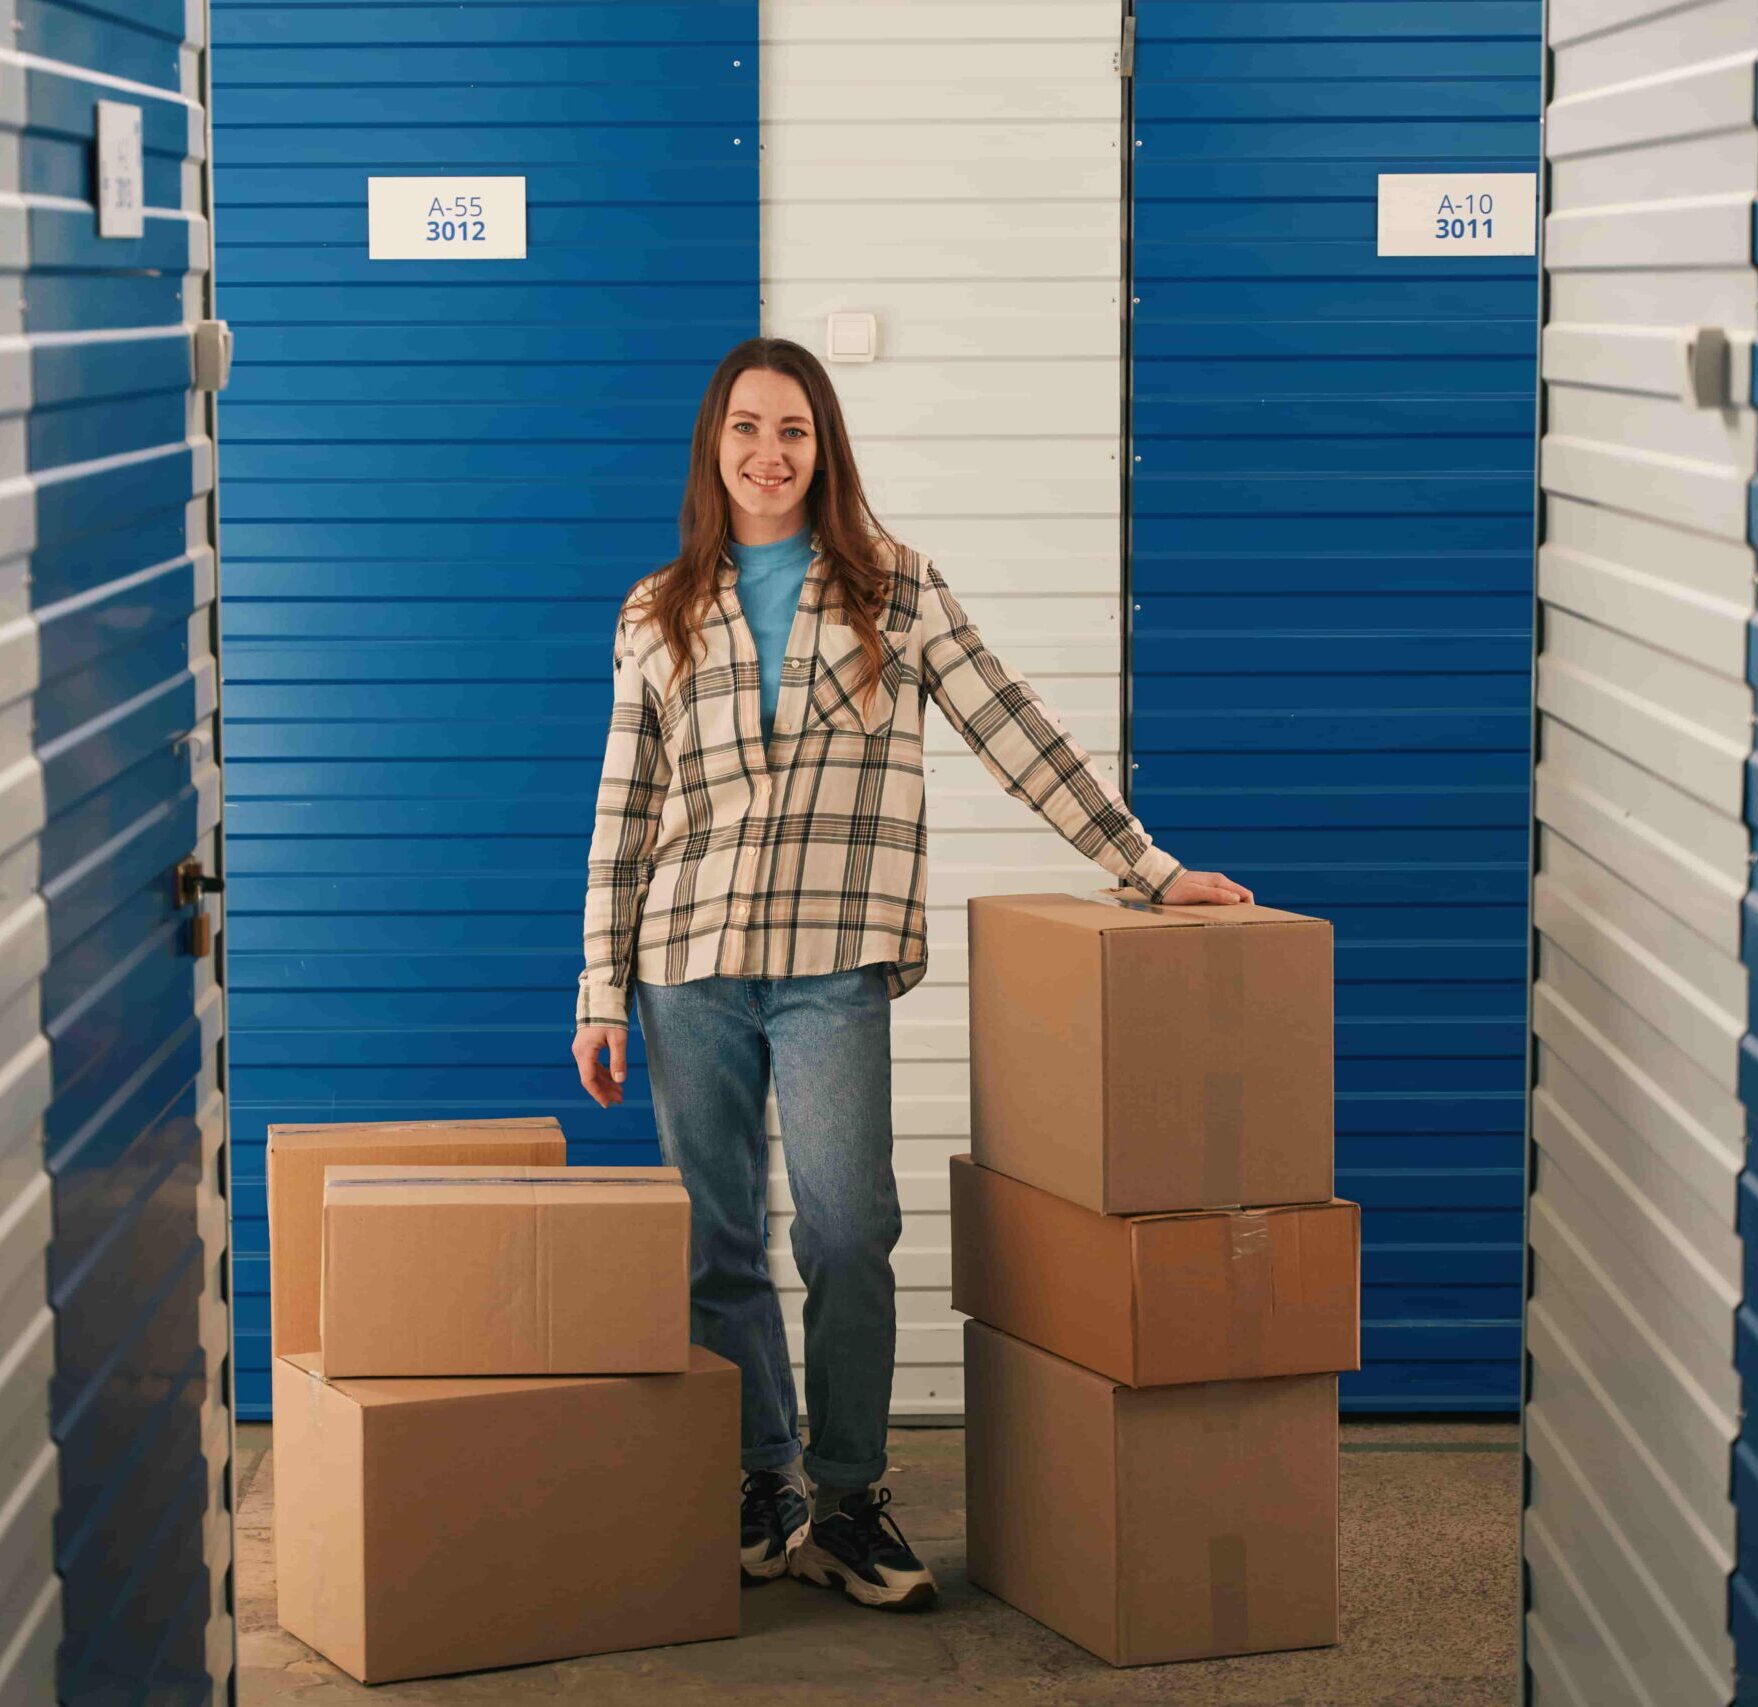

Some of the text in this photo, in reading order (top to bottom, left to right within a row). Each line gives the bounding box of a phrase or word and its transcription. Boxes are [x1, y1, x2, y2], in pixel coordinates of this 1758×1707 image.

[428, 197, 483, 217] A-55
[1438, 194, 1493, 214] A-10
[426, 221, 486, 241] 3012
[1435, 218, 1493, 239] 3011
